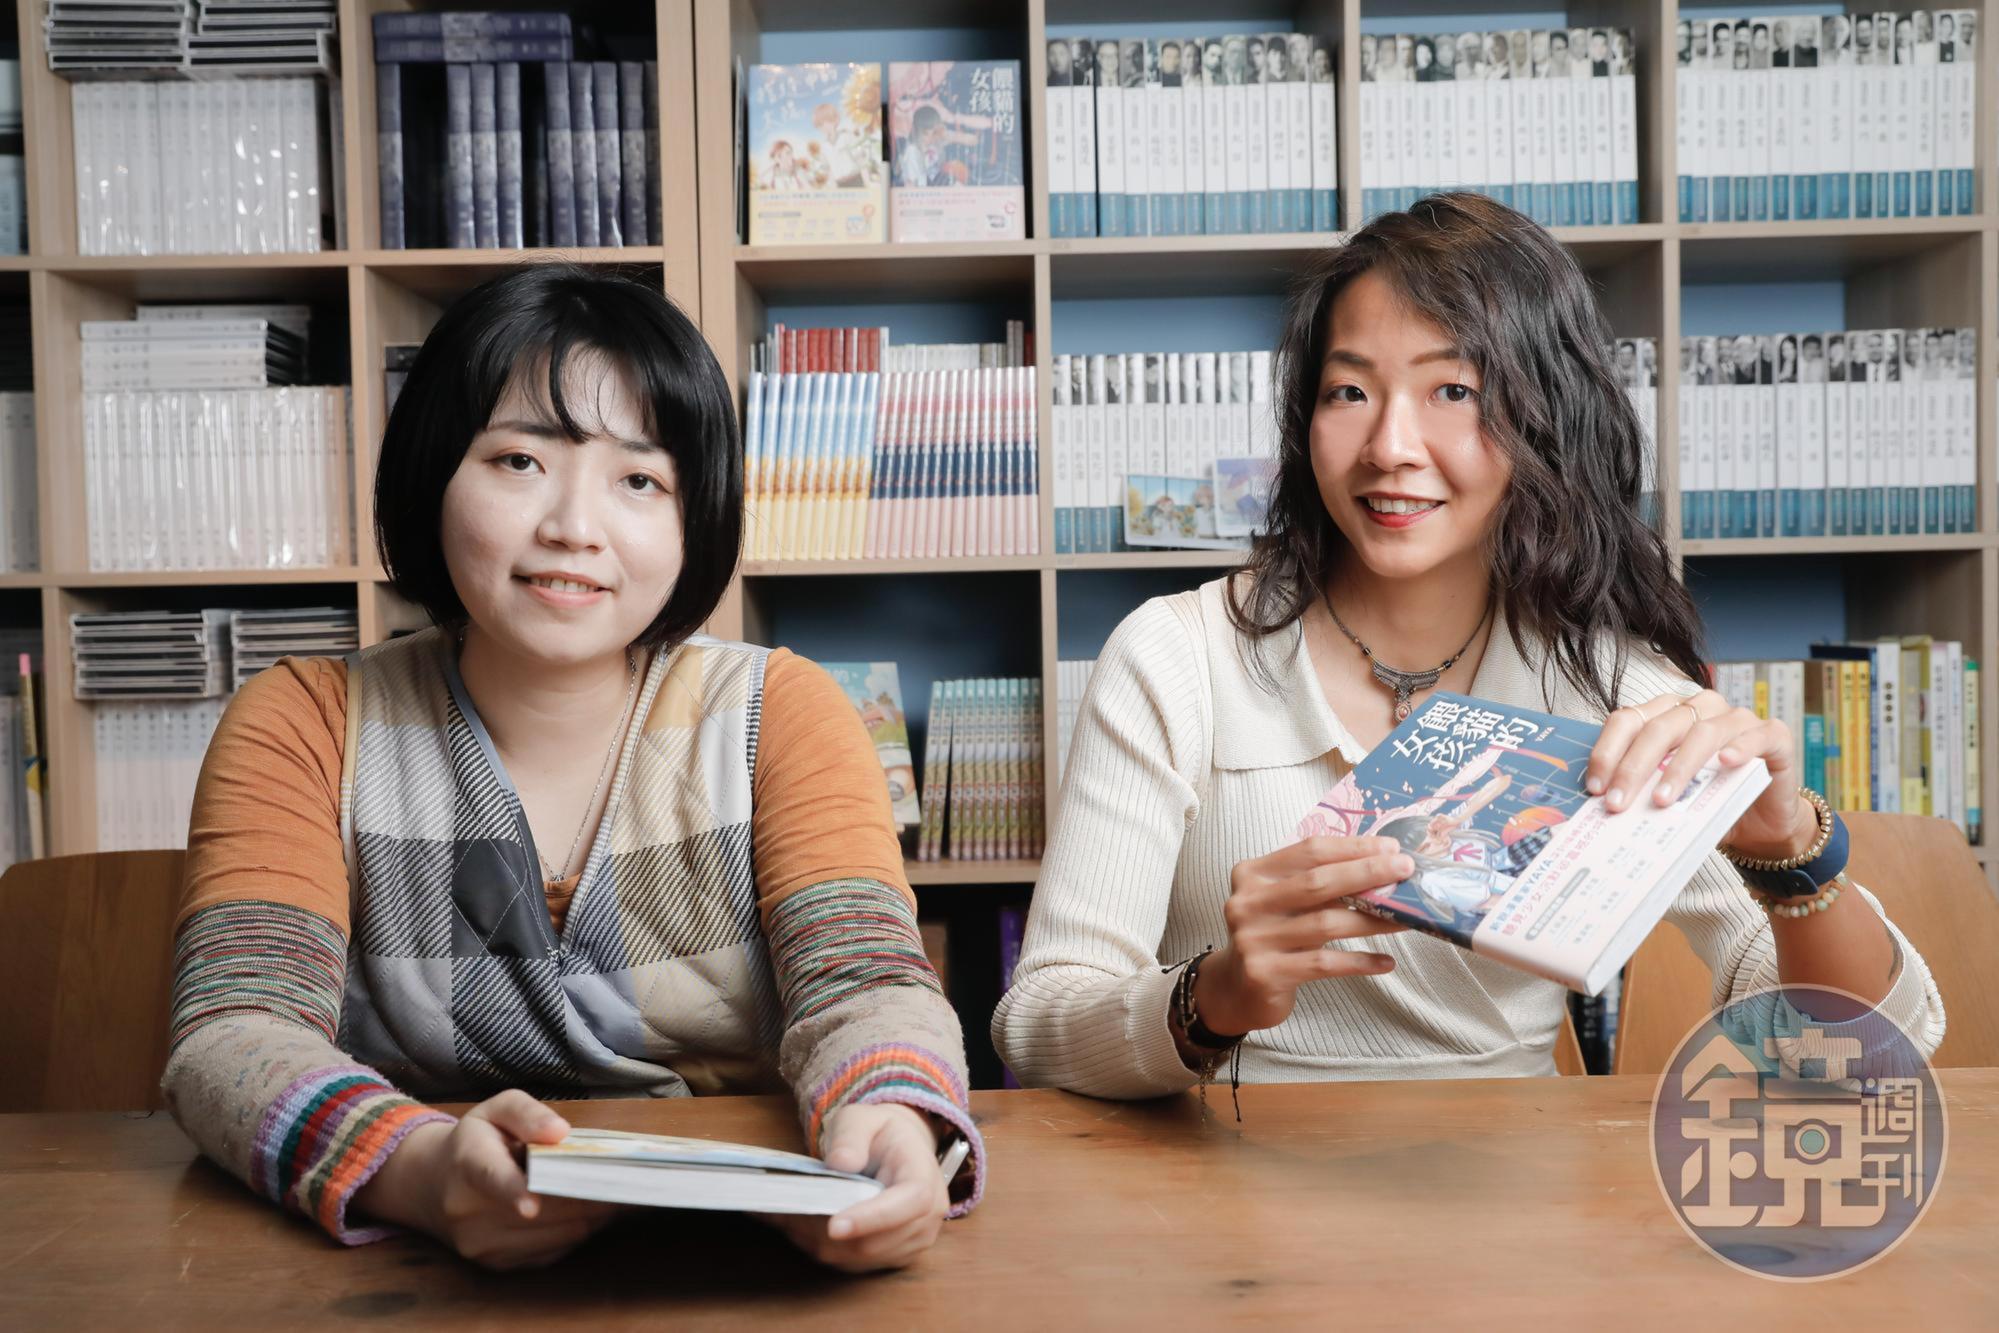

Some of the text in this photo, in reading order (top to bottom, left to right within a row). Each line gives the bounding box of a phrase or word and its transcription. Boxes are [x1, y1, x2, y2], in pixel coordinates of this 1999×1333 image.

[969, 66, 992, 113] 女孩
[1416, 700, 1540, 750] 餵貓的
[1390, 728, 1477, 772] 女孩
